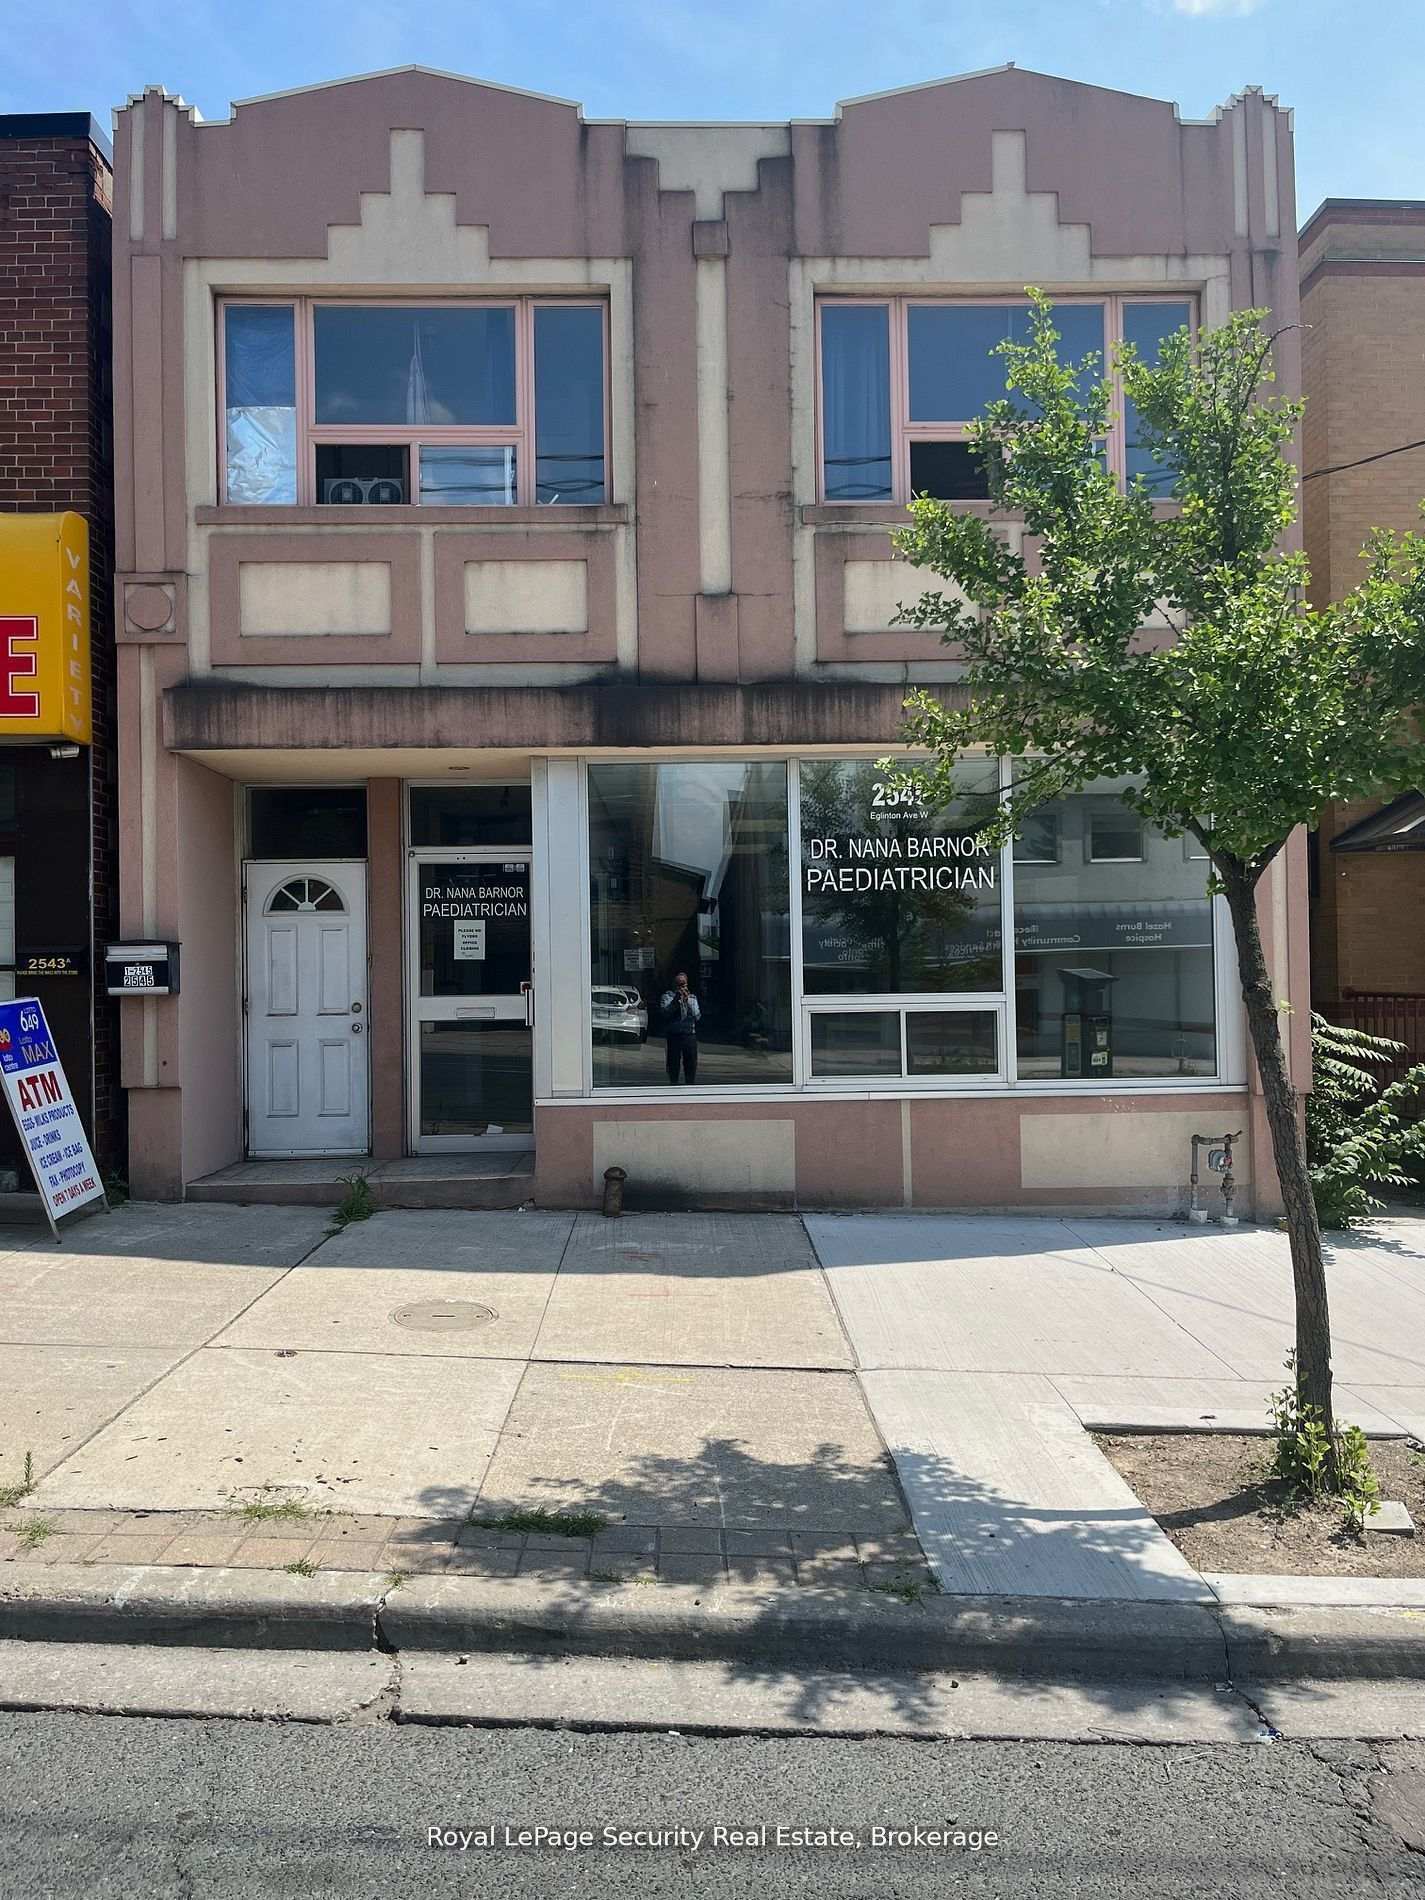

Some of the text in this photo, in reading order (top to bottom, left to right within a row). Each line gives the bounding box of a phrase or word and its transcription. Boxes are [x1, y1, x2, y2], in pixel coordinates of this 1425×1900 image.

[66, 547, 83, 733] VARIETY
[870, 811, 929, 821] Eglinton Ave W
[811, 838, 843, 859] DR.
[849, 838, 902, 859] NANA
[807, 866, 995, 892] PAEDIATRICIAN
[425, 887, 524, 899] DR. NANA BARNOR
[423, 903, 527, 917] PAEDIATRICIAN
[124, 975, 154, 987] 2545
[20, 1010, 39, 1032] 649
[21, 1041, 54, 1064] MAX
[17, 1070, 63, 1112] ATM
[48, 1104, 75, 1121] PRODUCTS
[43, 1129, 61, 1146] DRINKS
[40, 1156, 49, 1169] ICE
[46, 1150, 63, 1166] CREAM
[64, 1145, 73, 1159] ICE
[71, 1142, 83, 1156] BAG
[48, 1174, 59, 1188] FAX
[59, 1161, 86, 1183] PHOTOCOPY
[52, 1192, 67, 1207] OPEN
[67, 1184, 81, 1199] DAYS
[82, 1177, 97, 1190] WEEK
